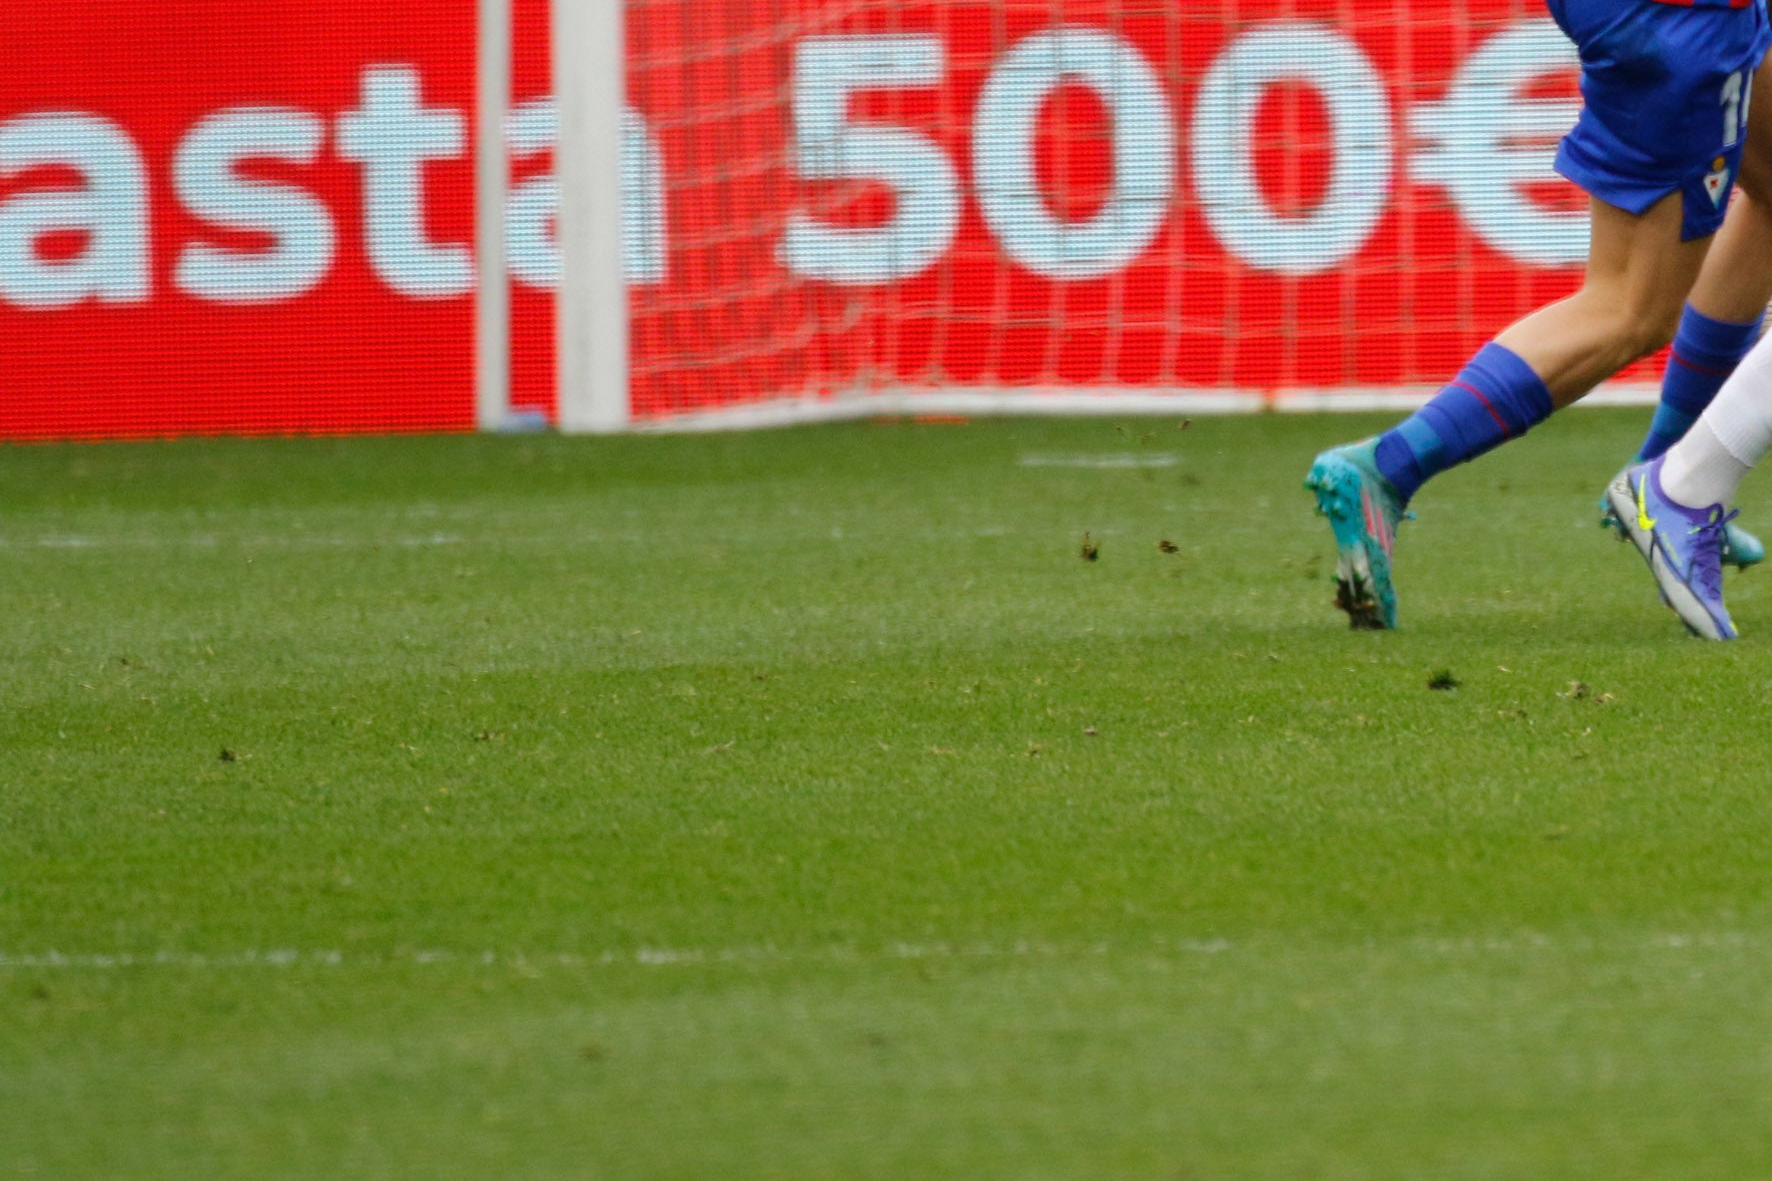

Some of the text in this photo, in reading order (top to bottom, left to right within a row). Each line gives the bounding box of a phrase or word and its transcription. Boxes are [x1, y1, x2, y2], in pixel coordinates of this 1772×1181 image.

[0, 21, 1592, 307] asta 500€
[1720, 69, 1754, 147] 1
